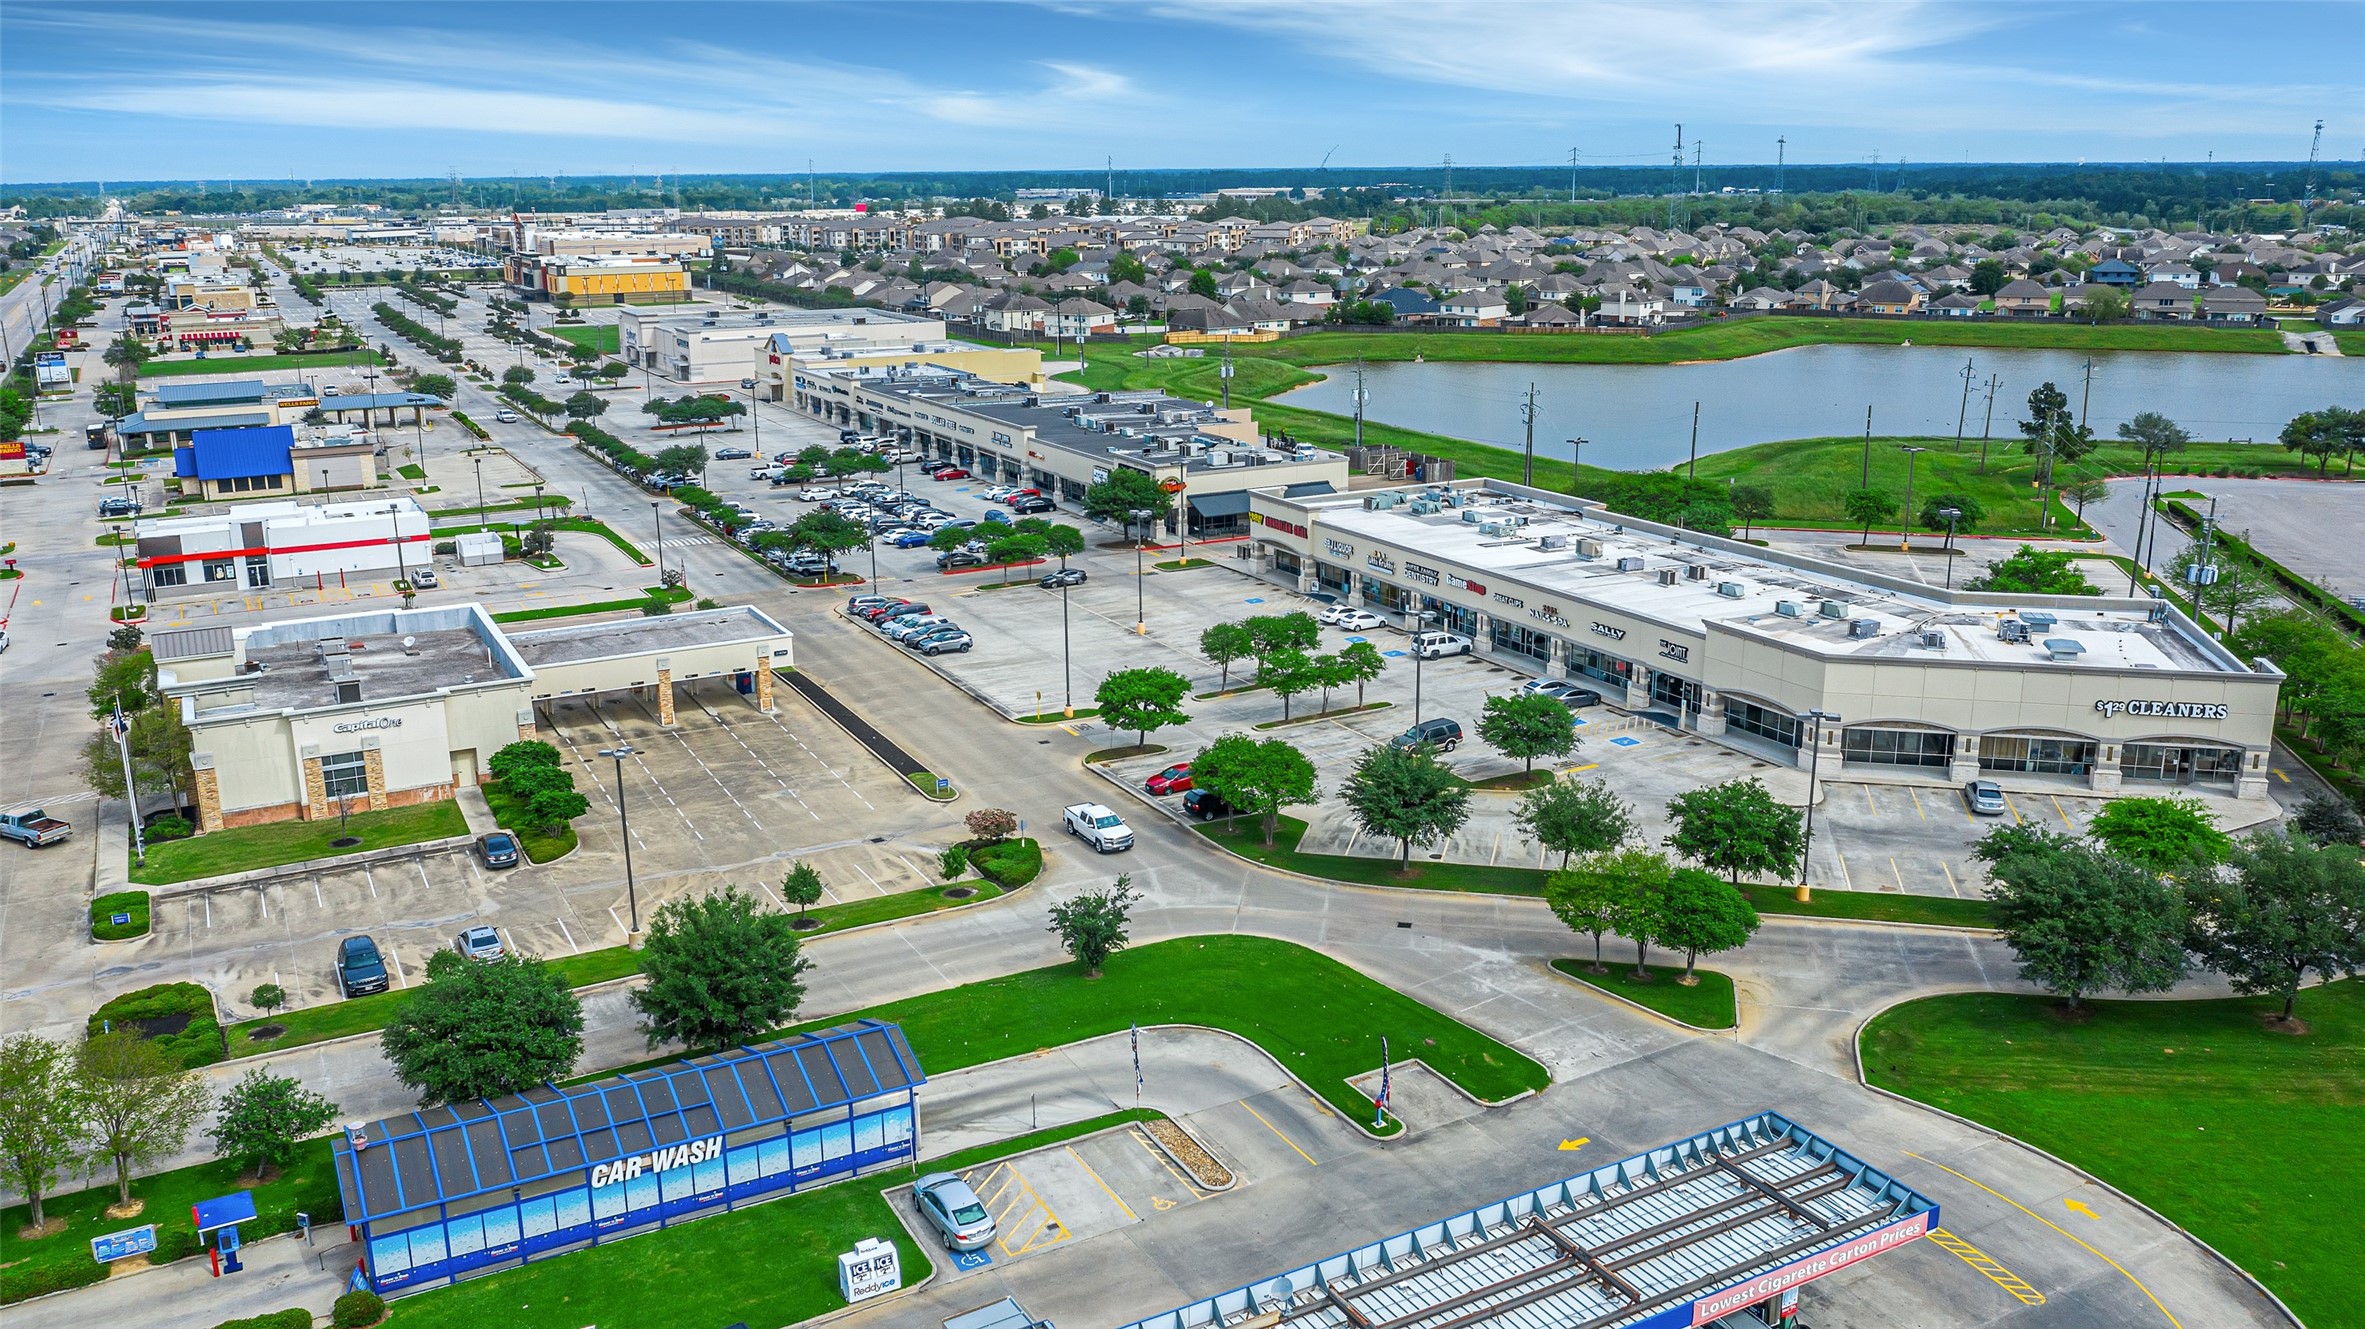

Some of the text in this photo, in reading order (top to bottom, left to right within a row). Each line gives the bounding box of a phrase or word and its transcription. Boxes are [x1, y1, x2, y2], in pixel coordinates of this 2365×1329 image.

[1333, 540, 1354, 555] LIQUOR
[1404, 570, 1439, 587] DENTISTRY
[1446, 574, 1486, 595] GameStop
[1493, 593, 1524, 609] GREAT CLIPS
[1590, 622, 1626, 638] SALLY
[2127, 699, 2228, 720] CLEANERS
[591, 1135, 723, 1189] CAR WASH
[852, 1261, 869, 1276] ICE
[876, 1255, 893, 1269] ICE
[1700, 1286, 1755, 1318] Lowest
[1758, 1261, 1827, 1293] Cigarette
[1829, 1240, 1877, 1266] Carton
[1880, 1222, 1921, 1248] Prices
